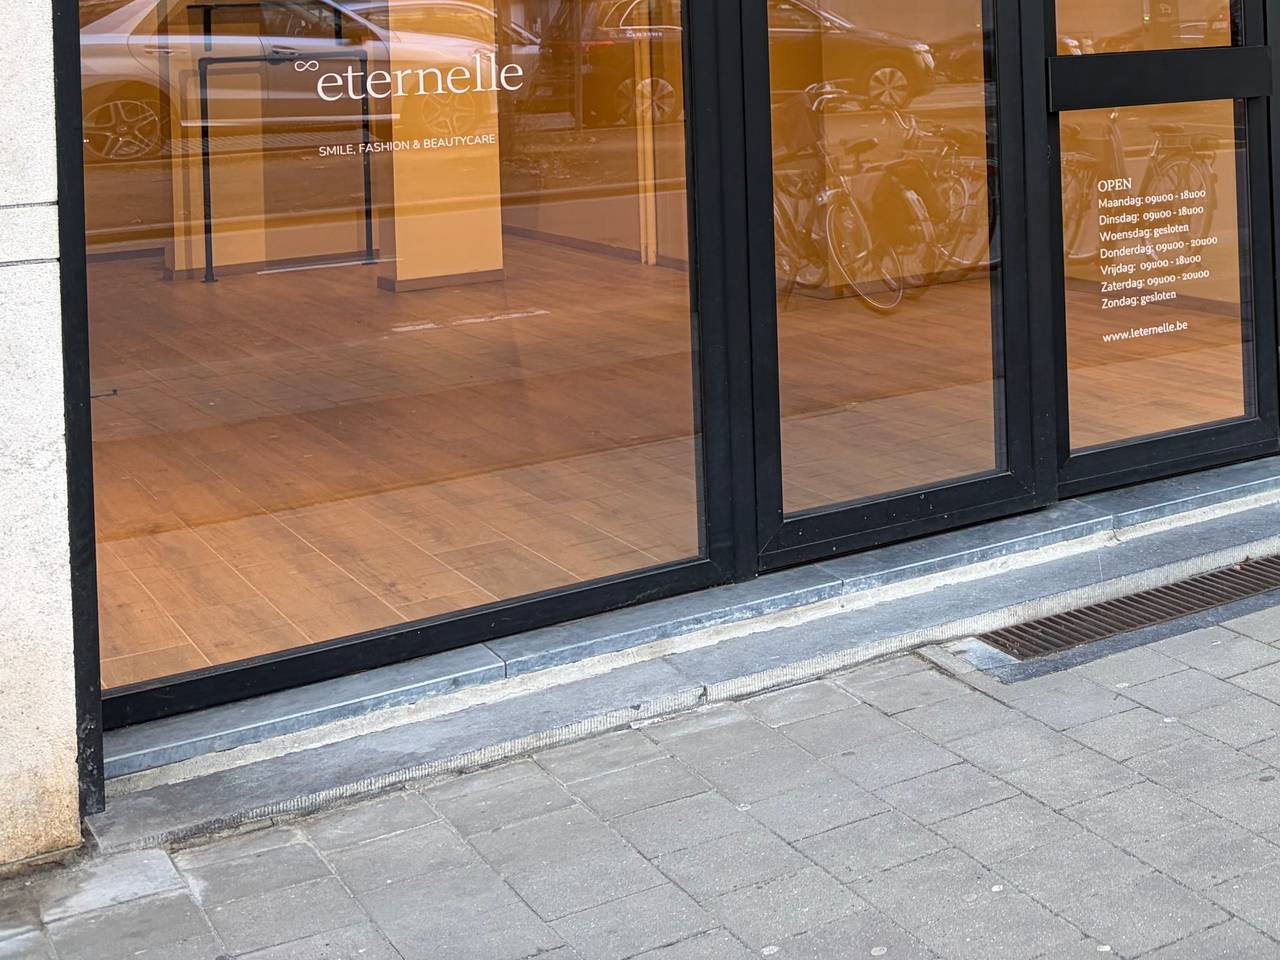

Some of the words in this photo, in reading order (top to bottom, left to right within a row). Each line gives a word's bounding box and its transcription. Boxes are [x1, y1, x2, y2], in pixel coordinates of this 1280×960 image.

[319, 144, 356, 157] SMILE,
[359, 140, 410, 154] FASHION
[412, 139, 421, 150] &
[423, 134, 496, 149] BEAUTYCARE
[1098, 178, 1132, 192] OPEN
[1098, 196, 1143, 208] Maandag:
[1145, 193, 1173, 204] 09u00
[1180, 190, 1206, 200] 18u00
[1099, 213, 1140, 225] Dinsdag:
[1143, 210, 1171, 221] 09u00
[1178, 206, 1204, 216] 18u00
[1100, 227, 1152, 242] Woensdag:
[1153, 224, 1189, 238] gesloten
[1100, 244, 1154, 259] Donderdag:
[1156, 240, 1184, 252] 09u00
[1190, 236, 1218, 247] 20u00
[1100, 264, 1136, 276] Vrijdag:
[1140, 259, 1169, 271] 09u00
[1176, 255, 1201, 265] 18u00
[1101, 279, 1145, 292] Zaterdag:
[1147, 275, 1176, 286] 09u00
[1182, 270, 1210, 281] 20u00
[1101, 296, 1139, 309] Zondag:
[1140, 291, 1177, 305] gesloten
[1102, 320, 1188, 342] www.leternelle.be
